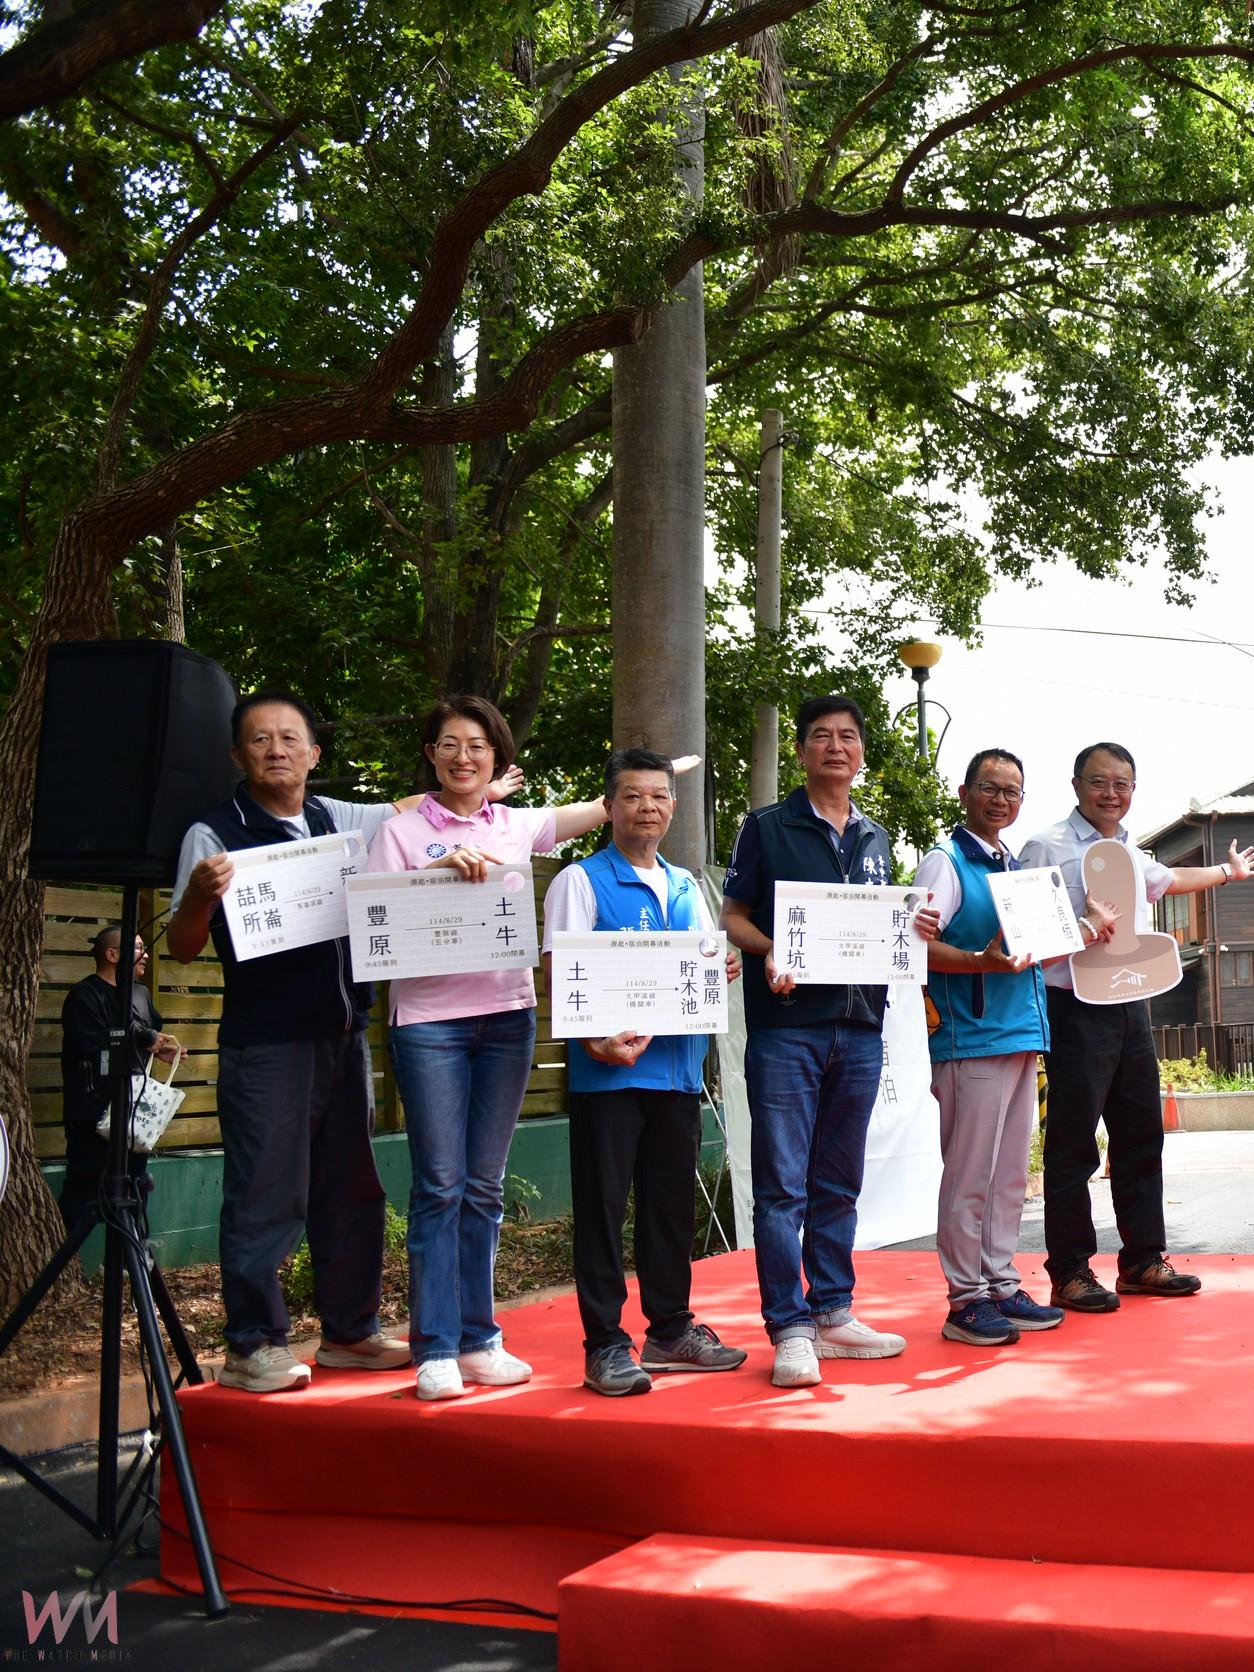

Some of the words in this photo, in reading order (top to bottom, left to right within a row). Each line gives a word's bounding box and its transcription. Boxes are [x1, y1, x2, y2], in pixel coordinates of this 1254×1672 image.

[494, 896, 518, 947] 土牛
[787, 906, 806, 969] 麻竹坑
[892, 909, 911, 971] 貯木場
[567, 961, 588, 1011] 土牛
